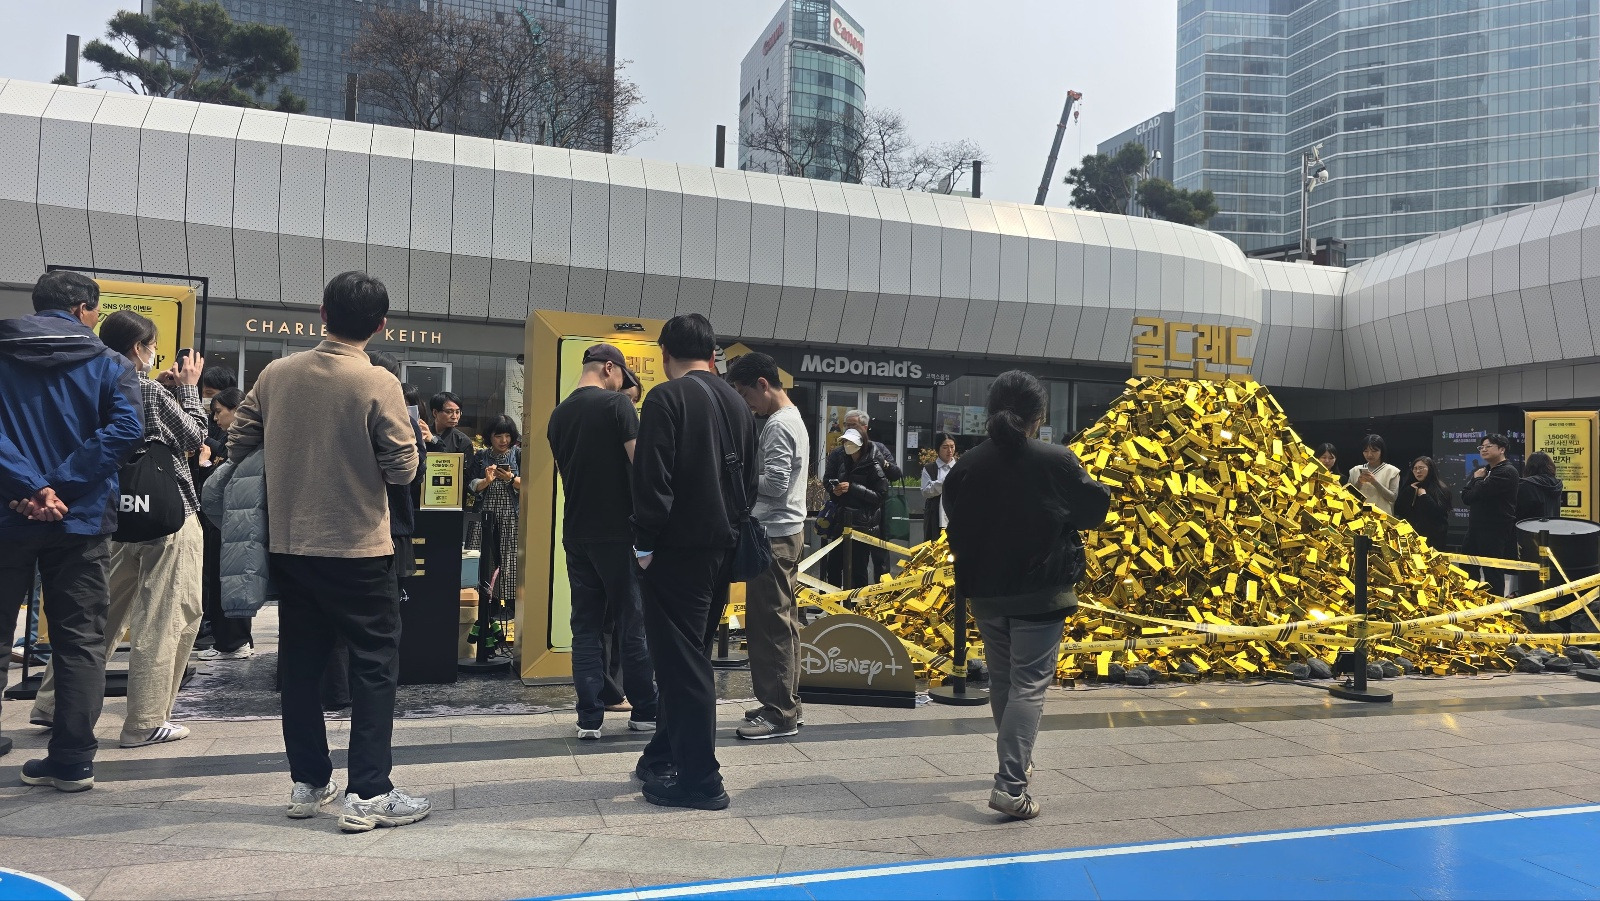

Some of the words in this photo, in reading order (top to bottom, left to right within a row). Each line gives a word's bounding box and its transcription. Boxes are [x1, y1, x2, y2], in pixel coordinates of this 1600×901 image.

[832, 17, 864, 56] Canon
[1135, 116, 1161, 136] GLAD
[245, 318, 328, 337] CHARLE
[385, 328, 442, 344] KEITH
[1131, 316, 1254, 381] 골드랜드
[800, 354, 923, 379] McDonald's
[116, 494, 150, 513] BN
[800, 642, 903, 686] Disney+
